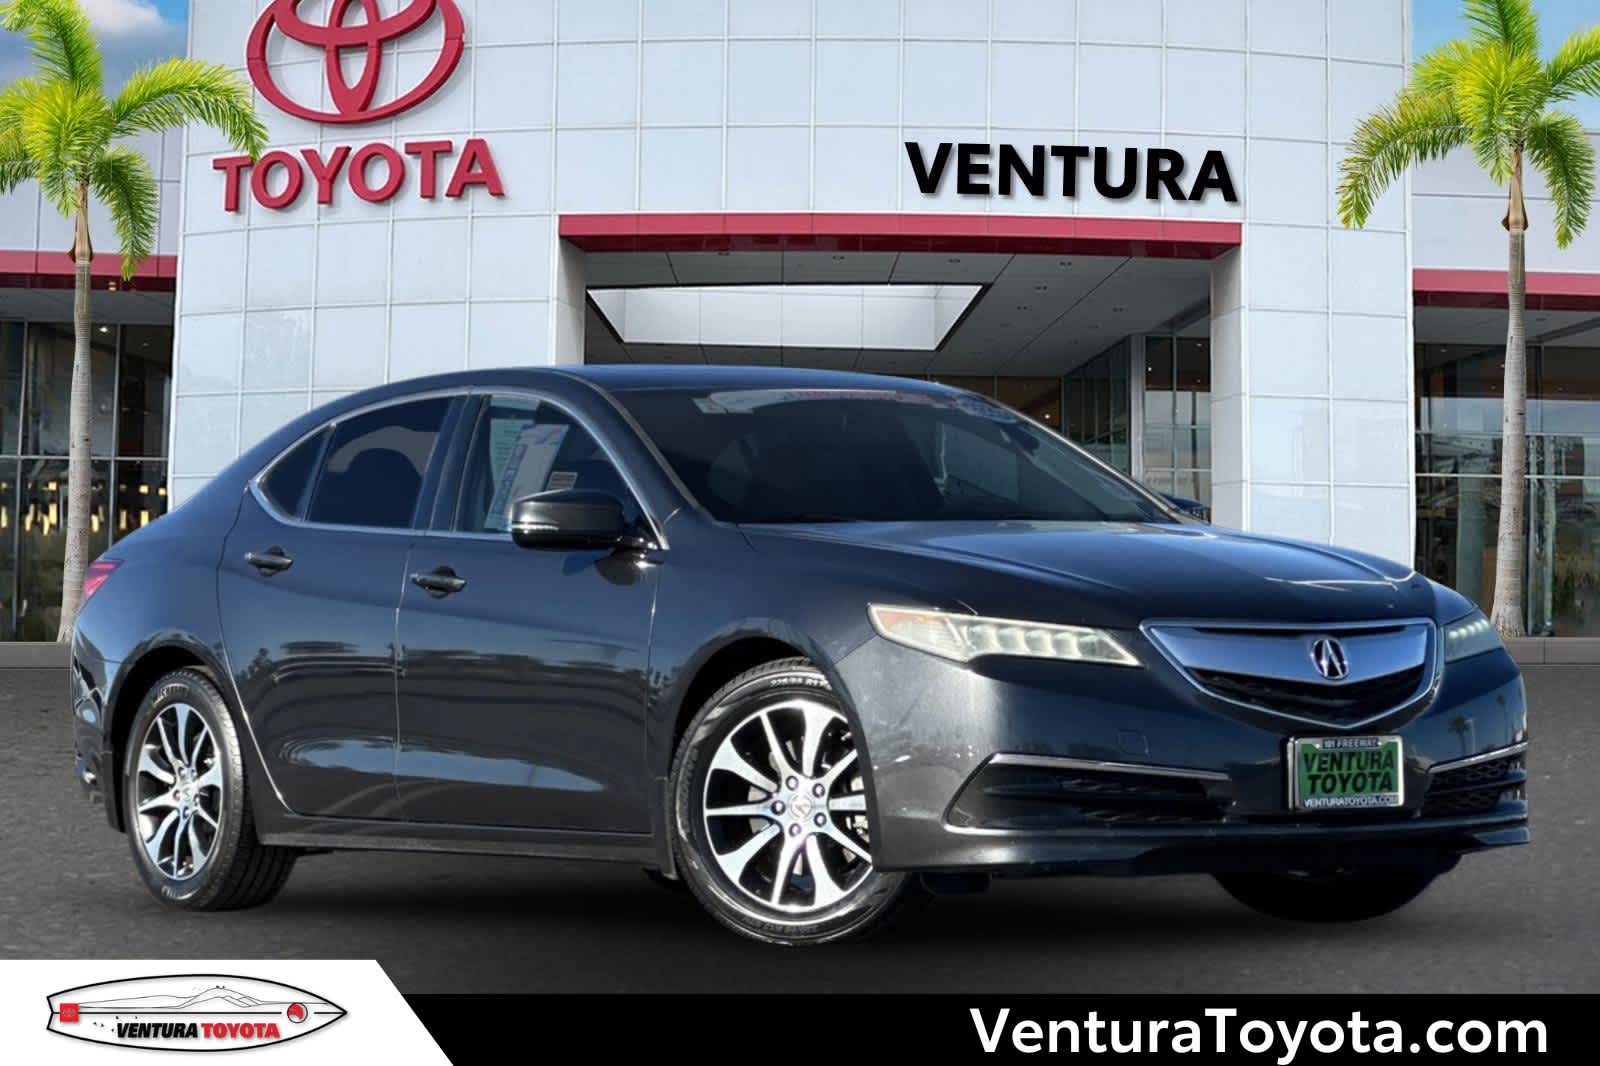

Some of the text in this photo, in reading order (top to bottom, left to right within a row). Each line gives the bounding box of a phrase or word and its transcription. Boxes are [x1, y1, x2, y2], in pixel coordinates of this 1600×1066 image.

[213, 138, 505, 212] TOYOTA
[904, 141, 1238, 203] VENTURA
[1304, 751, 1394, 772] VENTURA
[1308, 771, 1393, 794] TOYOTA
